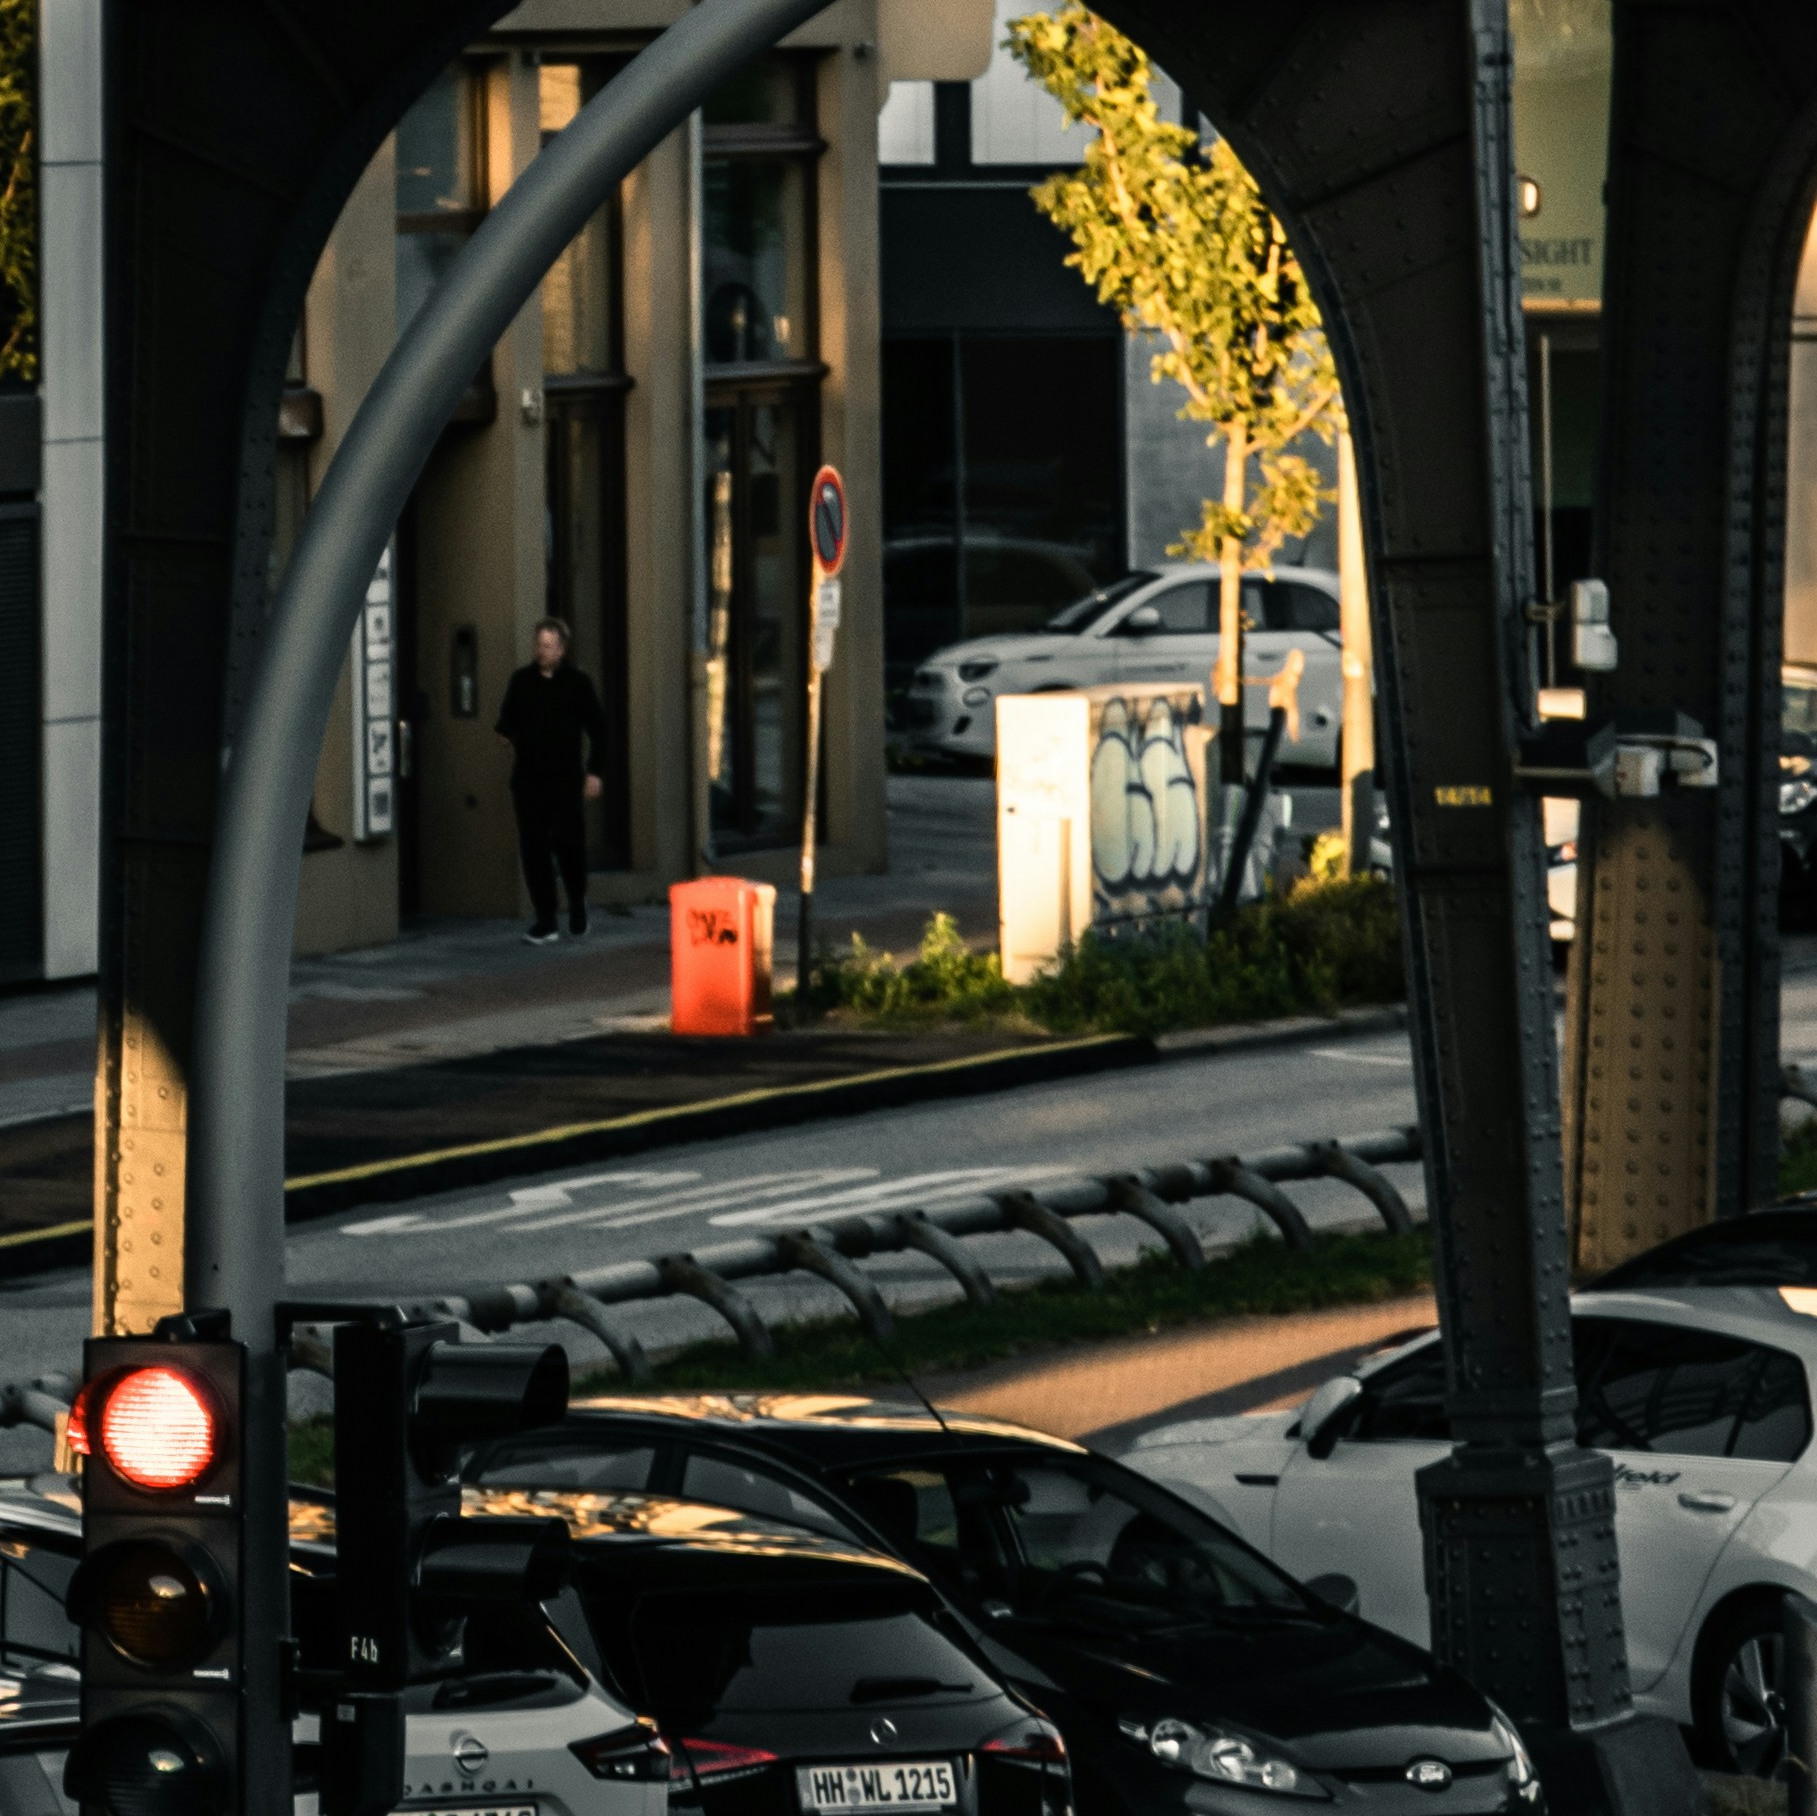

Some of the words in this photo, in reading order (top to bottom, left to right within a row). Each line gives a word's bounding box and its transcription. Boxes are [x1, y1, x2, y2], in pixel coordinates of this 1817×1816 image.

[813, 1772, 845, 1804] HH
[860, 1770, 892, 1801] WL
[895, 1768, 951, 1800] 1215
